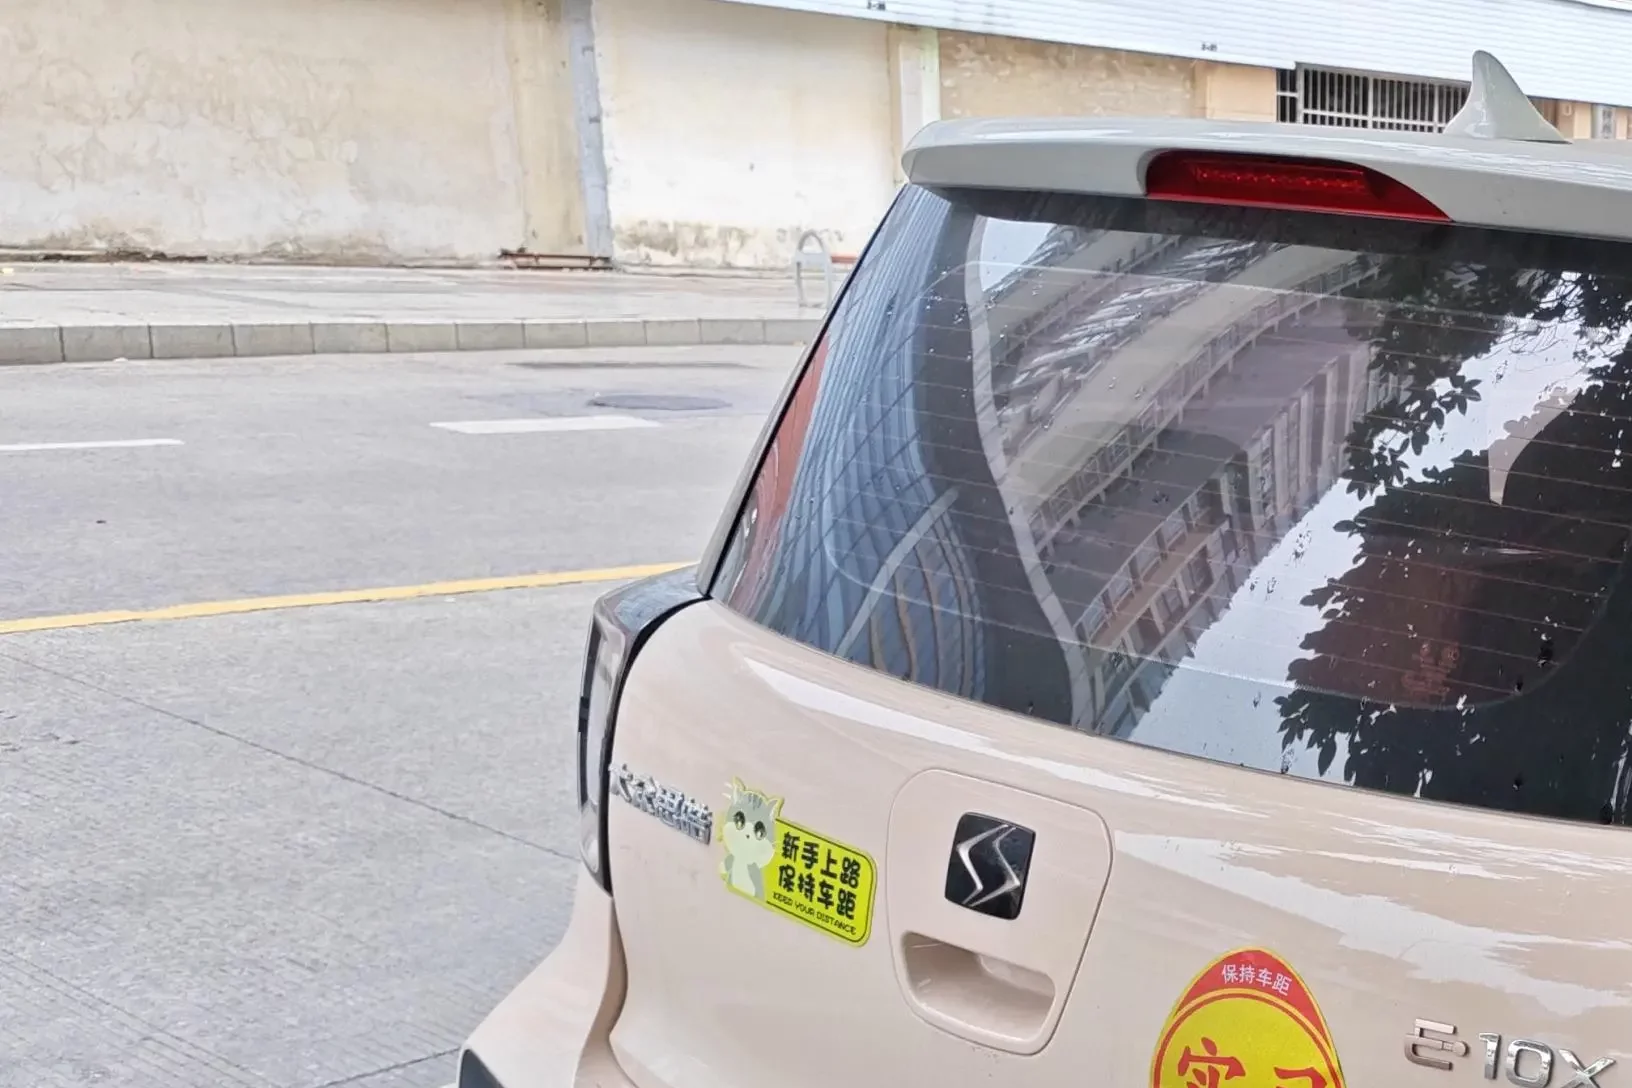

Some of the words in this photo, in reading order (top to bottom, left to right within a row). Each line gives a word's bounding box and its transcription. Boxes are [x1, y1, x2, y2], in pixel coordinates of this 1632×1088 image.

[782, 831, 861, 889] 新手上路
[778, 864, 857, 920] 保持车距
[794, 902, 816, 917] YOUR
[816, 911, 857, 936] DISTANCE
[1222, 963, 1293, 996] 保持车距
